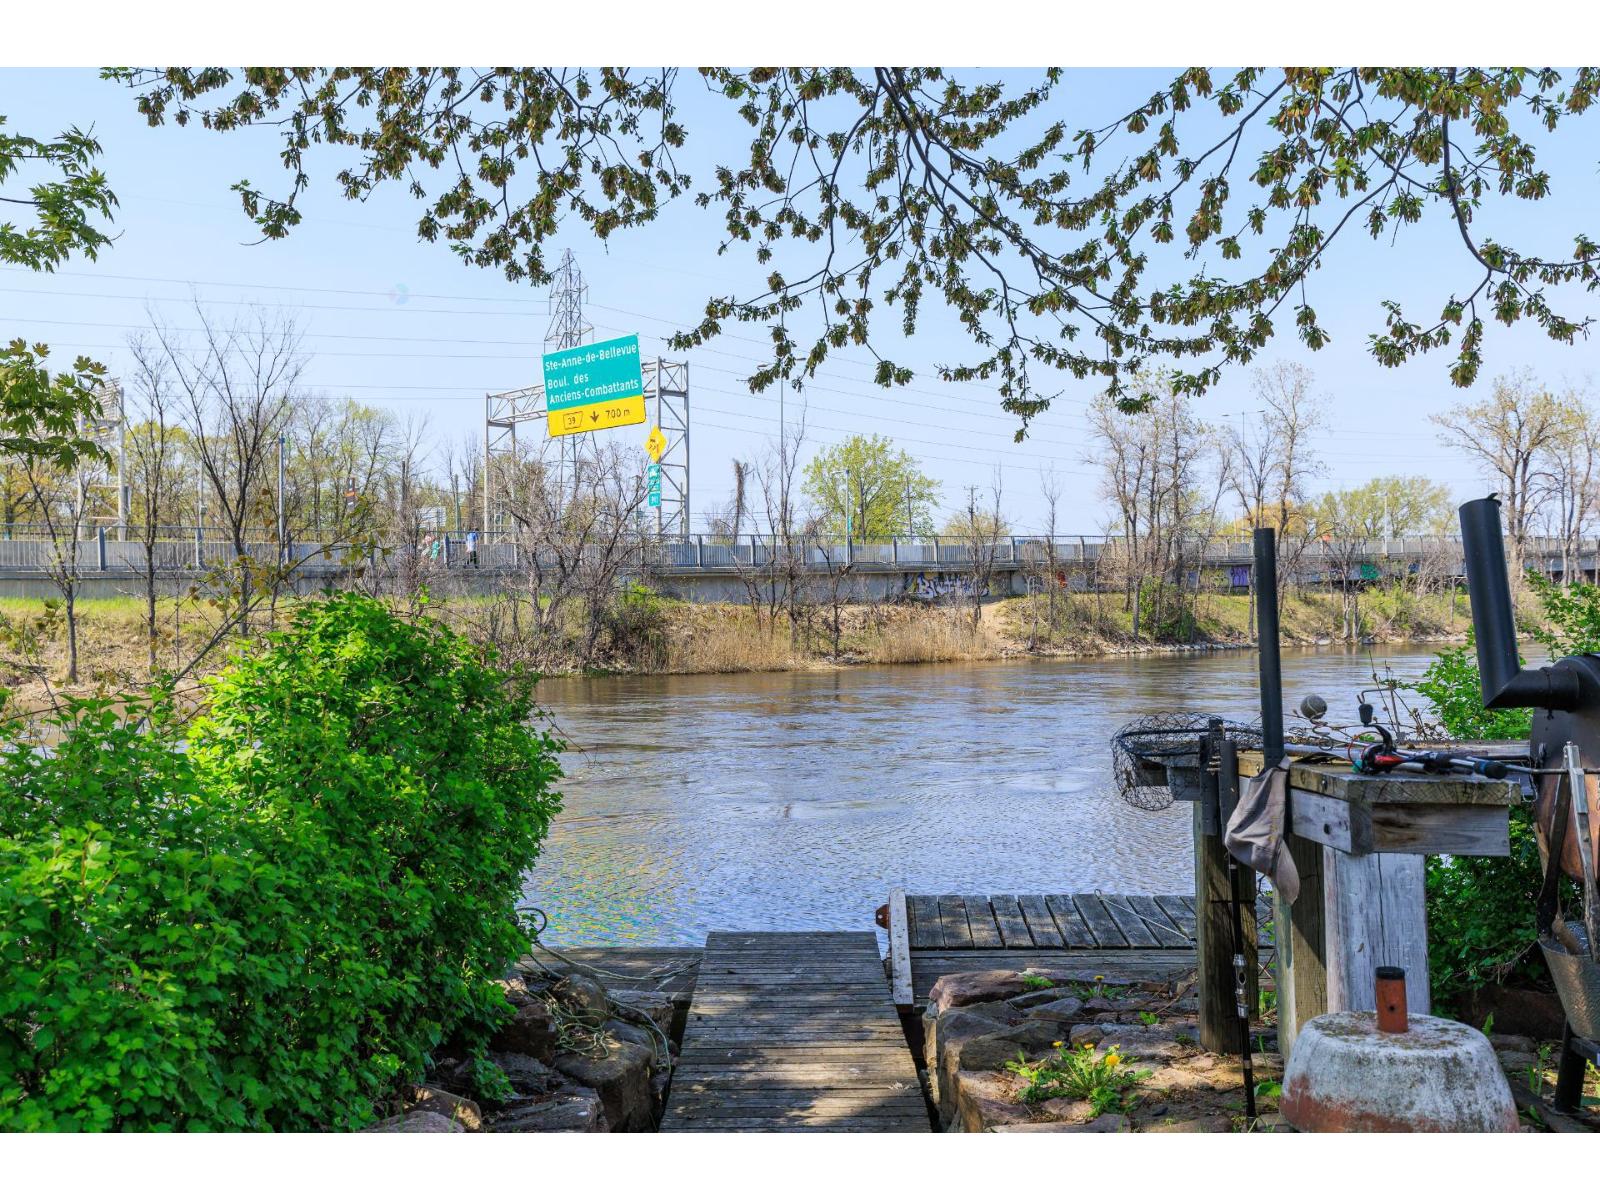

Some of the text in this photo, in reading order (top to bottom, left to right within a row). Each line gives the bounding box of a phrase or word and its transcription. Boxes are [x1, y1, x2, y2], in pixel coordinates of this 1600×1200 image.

[545, 344, 637, 371] Ste-Anne-de-Bellevue
[547, 373, 589, 389] Boul. des
[549, 379, 639, 404] Anciens-Combattants
[605, 408, 621, 419] 700
